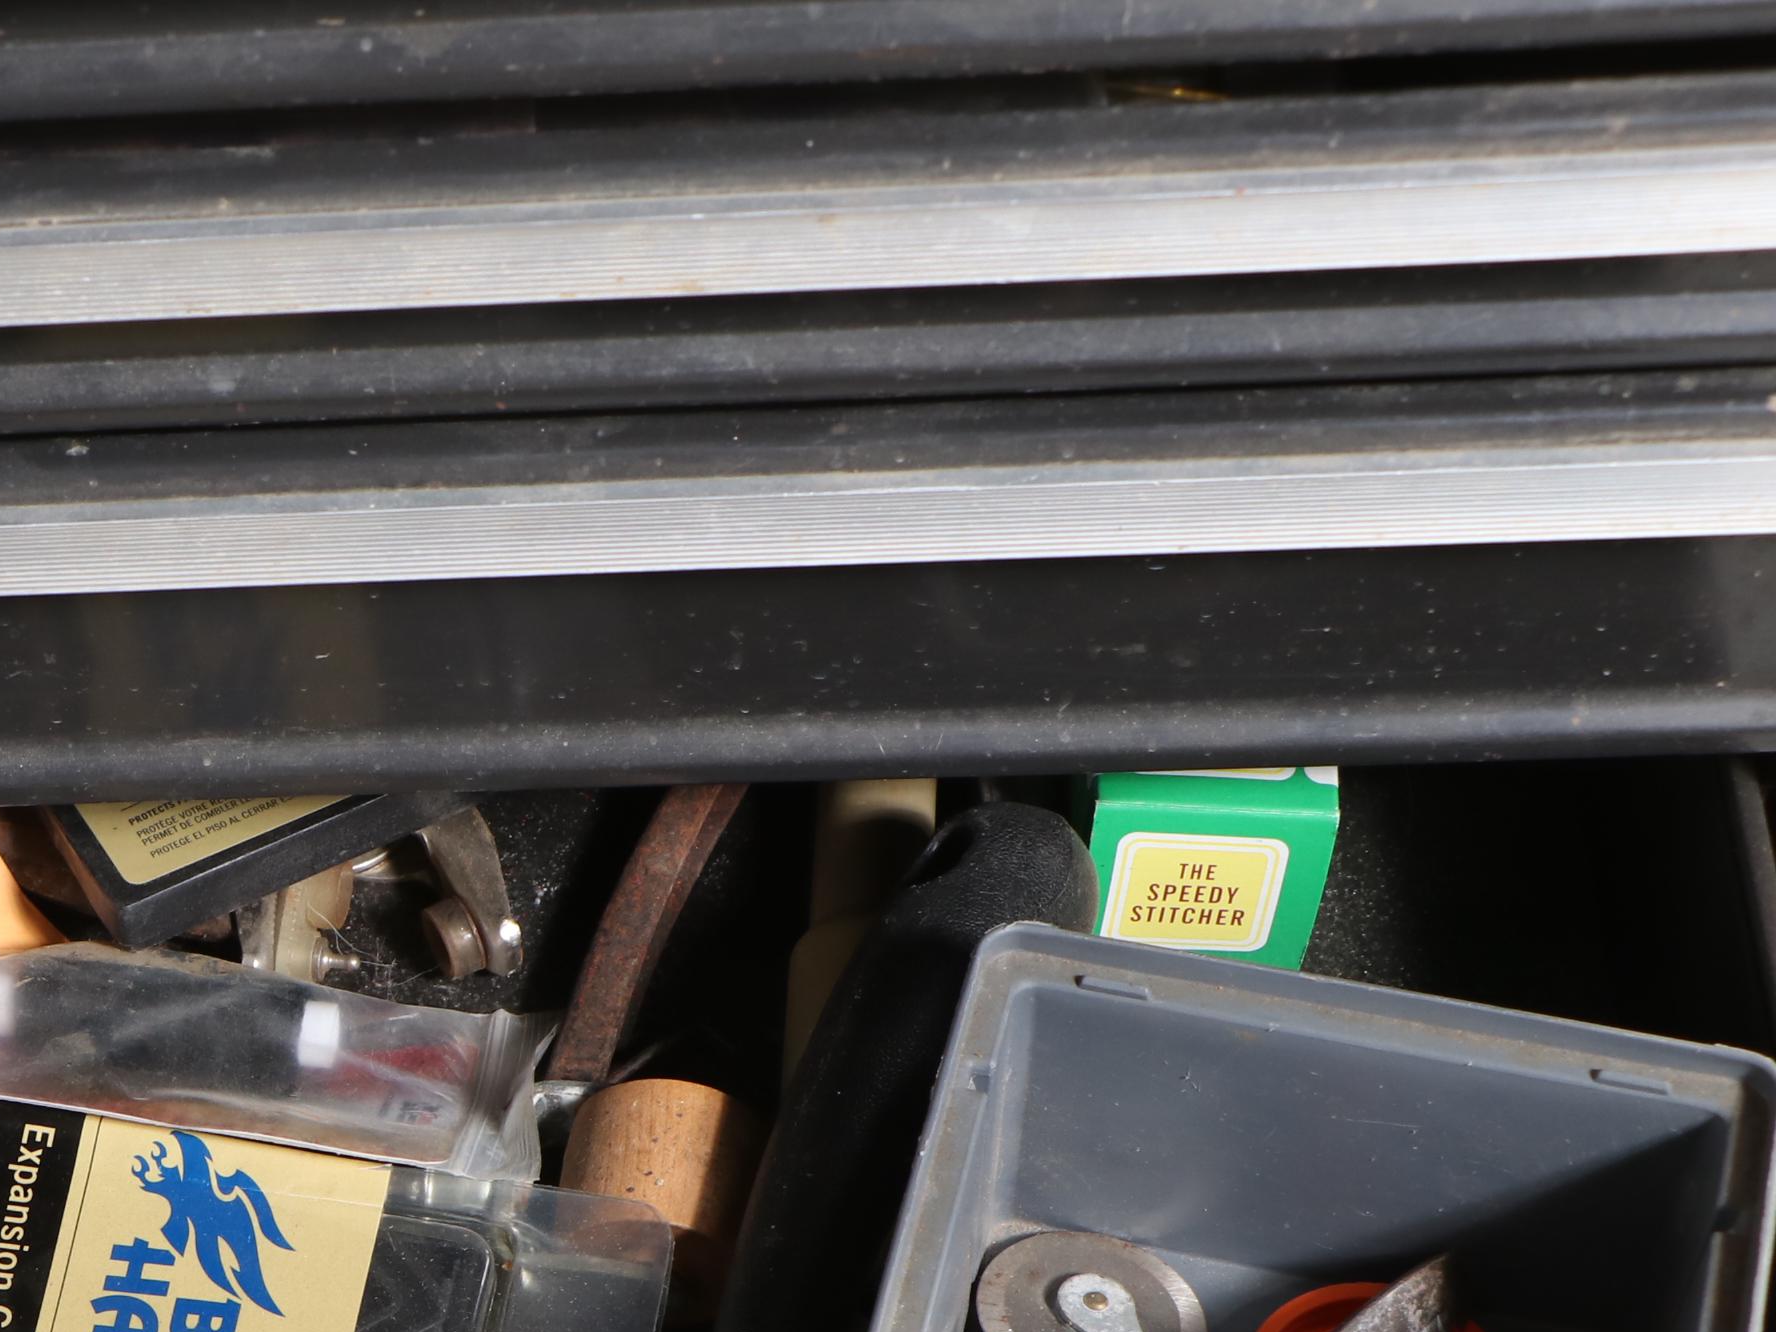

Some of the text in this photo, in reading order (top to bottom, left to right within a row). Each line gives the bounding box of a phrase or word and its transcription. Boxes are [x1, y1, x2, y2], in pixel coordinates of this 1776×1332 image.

[128, 802, 175, 826] PROTECTS
[177, 803, 209, 822] VOTRE
[141, 802, 237, 846] PERMET DE COMBLER
[150, 835, 192, 859] PROTEGE
[193, 829, 205, 842] EL
[206, 819, 227, 837] PISO
[227, 815, 241, 829] AL
[1179, 863, 1218, 881] THE
[1147, 883, 1240, 905] SPEEDY
[1129, 906, 1245, 927] STITCHER
